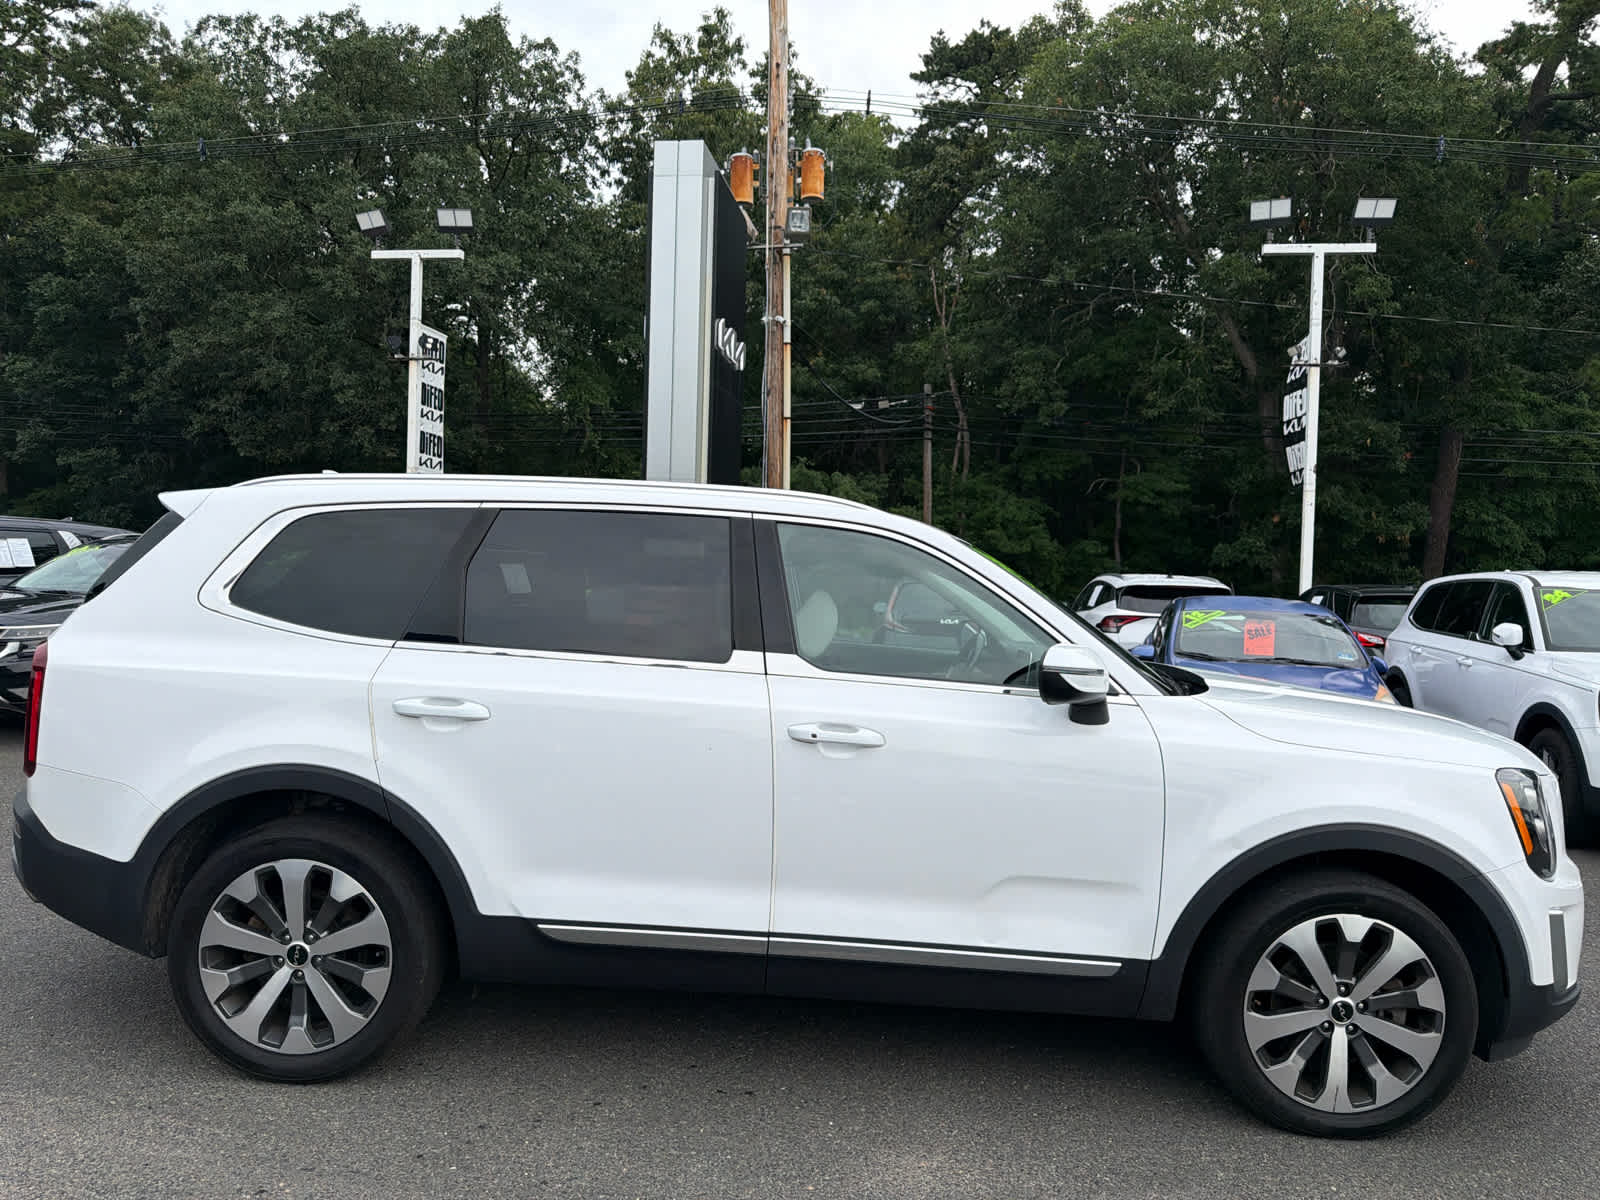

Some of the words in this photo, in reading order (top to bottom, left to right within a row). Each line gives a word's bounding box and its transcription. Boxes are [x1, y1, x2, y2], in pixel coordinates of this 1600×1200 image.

[714, 318, 746, 371] KIA
[421, 359, 445, 376] KIA
[420, 407, 443, 424] KIA
[419, 456, 442, 470] KIA
[1247, 624, 1273, 640] SALE
